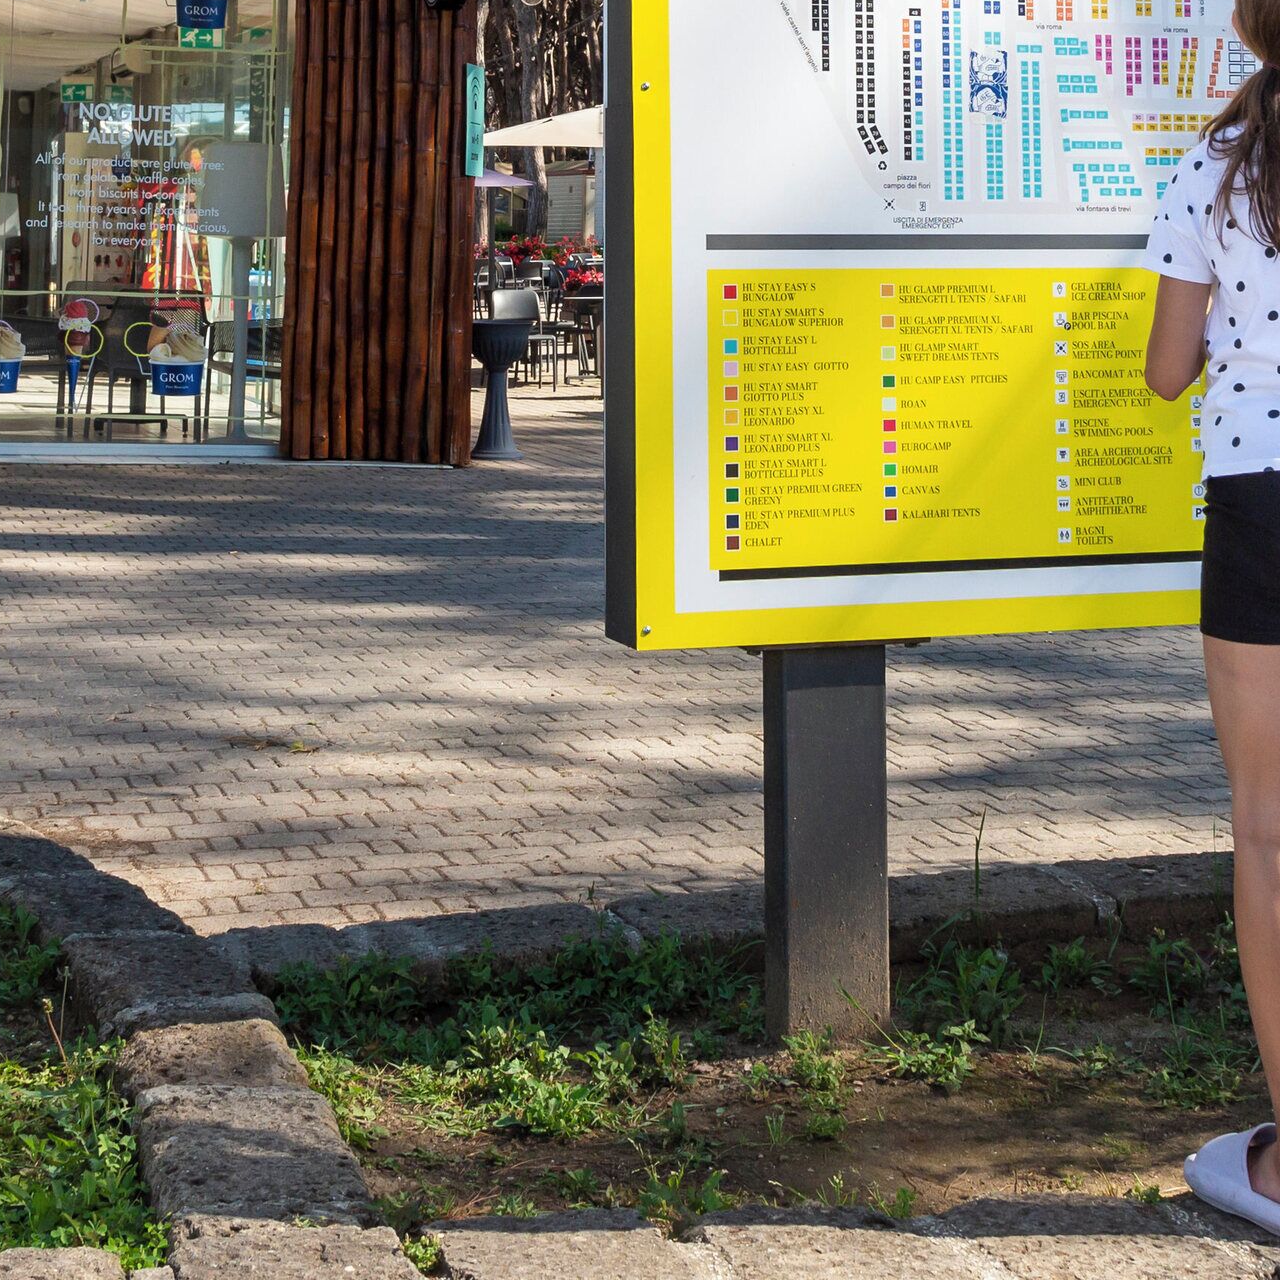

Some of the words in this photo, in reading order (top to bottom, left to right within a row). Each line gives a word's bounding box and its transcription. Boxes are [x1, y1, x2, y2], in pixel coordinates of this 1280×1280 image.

[184, 5, 218, 15] GROM
[79, 103, 110, 119] NO
[115, 105, 187, 123] GLUTEN
[87, 128, 177, 147] ALLOWED
[897, 174, 917, 182] piazza
[743, 283, 755, 292] HU
[758, 283, 782, 292] STAY
[785, 283, 808, 291] EASY
[810, 283, 816, 291] S
[1071, 283, 1122, 291] GELATERIA
[743, 293, 796, 301] BUNGALOW
[1072, 293, 1086, 301] ICE
[1089, 293, 1120, 301] CREAM
[1123, 292, 1146, 300] SHOP
[1072, 312, 1090, 320] BAR
[1093, 312, 1129, 320] PISCINA
[743, 318, 796, 327] BUNGALOW
[798, 318, 844, 326] SUPERIOR
[1072, 322, 1096, 330] POOL
[1098, 321, 1117, 329] BAR
[1072, 341, 1088, 349] SOS
[1091, 341, 1116, 349] AREA
[743, 346, 797, 355] BOTTICELLI
[1073, 350, 1113, 359] MEETING
[1115, 350, 1143, 358] POINT
[900, 353, 931, 362] SWEET
[932, 352, 969, 361] DREAMS
[970, 352, 999, 361] TENTS
[159, 372, 194, 384] GROM
[1073, 370, 1126, 379] BANCOMAT
[744, 393, 779, 401] GIOTTO
[781, 393, 804, 401] PLUS
[901, 400, 927, 408] ROAN
[1073, 399, 1128, 408] EMERGENCY
[1131, 398, 1152, 407] EXIT
[744, 417, 795, 426] LEONARDO
[901, 421, 934, 430] HUMAN
[937, 420, 972, 429] TRAVEL
[1074, 419, 1109, 427] PISCINE
[1074, 428, 1122, 437] SWIMMING
[1125, 428, 1153, 436] POOLS
[744, 444, 796, 453] LEONARDO
[797, 443, 820, 452] PLUS
[901, 442, 951, 451] EUROCAMP
[745, 469, 798, 479] BOTTICELLI
[801, 469, 823, 477] PLUS
[902, 465, 938, 474] HOMAIR
[1075, 477, 1095, 486] MINI
[1098, 477, 1121, 485] CLUB
[745, 487, 757, 495] HU
[760, 486, 785, 495] STAY
[787, 484, 830, 494] PREMIUM
[832, 483, 863, 493] GREEN
[902, 486, 940, 495] CANVAS
[745, 496, 782, 505] GREENY
[1076, 496, 1134, 506] ANFITEATRO
[902, 509, 950, 519] KALAHARI
[952, 508, 980, 517] TENTS
[1076, 505, 1147, 516] AMPHITHEATRE
[745, 521, 769, 530] EDEN
[1076, 526, 1104, 535] BAGNI
[745, 537, 782, 547] CHALET
[1076, 536, 1113, 545] TOILETS
